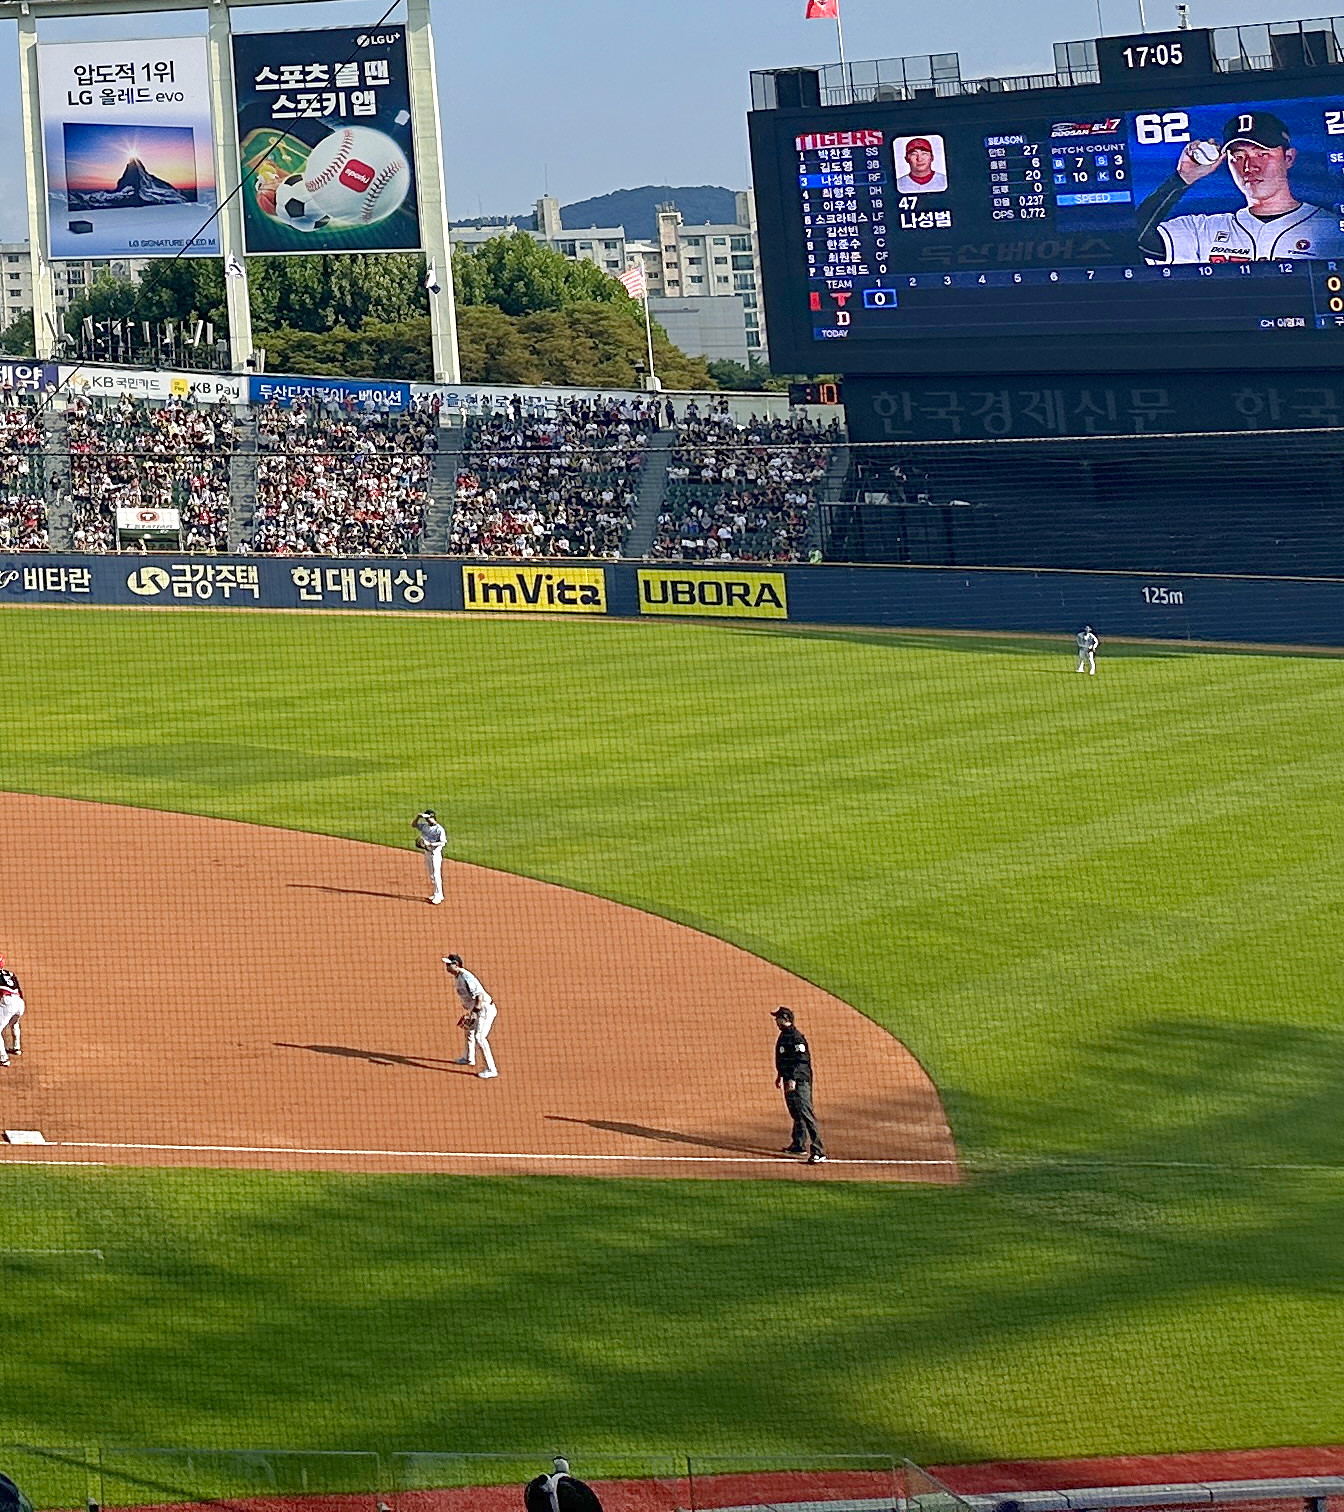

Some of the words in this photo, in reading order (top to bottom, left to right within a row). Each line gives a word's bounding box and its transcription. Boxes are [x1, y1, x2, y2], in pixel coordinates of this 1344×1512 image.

[1123, 44, 1183, 68] 17:05
[73, 63, 135, 86] 압도적
[141, 61, 175, 83] 1위
[255, 64, 330, 91] 스포츠
[334, 62, 359, 87] 볼
[364, 60, 389, 85] 땐
[68, 90, 93, 106] LG
[99, 88, 153, 105] 올레드
[156, 92, 184, 102] evo
[272, 92, 347, 119] 스포키
[351, 90, 376, 116] 앱
[1135, 112, 1190, 144] 62
[1238, 115, 1253, 132] D
[796, 129, 884, 151] TIGERS
[988, 136, 1023, 144] SEASON
[866, 148, 878, 156] SS
[1023, 145, 1038, 155] 27
[1052, 146, 1083, 155] PITCH
[1086, 144, 1125, 152] COUNT
[820, 161, 853, 172] 김도영
[867, 161, 879, 169] 3B
[1032, 158, 1040, 167] 6
[1075, 158, 1083, 167] 7
[1114, 155, 1123, 165] 3
[821, 173, 854, 186] 나성범
[868, 173, 881, 181] RF
[1026, 171, 1041, 180] 20
[1073, 172, 1088, 182] 10
[1116, 170, 1124, 179] 0
[870, 187, 882, 195] DH
[1034, 182, 1042, 192] 0
[899, 197, 917, 209] 47
[1019, 195, 1043, 206] 0.237
[1075, 193, 1111, 203] SPEED
[823, 200, 857, 211] 이우성
[871, 200, 883, 208] 1B
[872, 213, 884, 221] LF
[901, 211, 952, 228] 나성범
[1021, 208, 1045, 219] 0.772
[873, 226, 886, 234] 2B
[141, 239, 184, 247] SIGNATURE
[877, 239, 885, 247] C
[876, 252, 889, 260] CF
[826, 280, 852, 289] TEAM
[909, 277, 917, 286] 2
[944, 276, 952, 286] 3
[978, 274, 986, 284] 4
[1014, 274, 1022, 283] 5
[1050, 272, 1058, 282] 6
[1087, 270, 1095, 280] 7
[1125, 269, 1133, 278] 8
[1162, 267, 1171, 277] 9
[1198, 266, 1213, 276] 10
[1240, 265, 1251, 275] 11
[1279, 263, 1293, 273] 12
[874, 292, 885, 305] 0
[1327, 276, 1341, 292] 0
[836, 311, 851, 326] D
[1329, 297, 1343, 311] 0
[822, 330, 849, 338] TODAY
[93, 376, 113, 388] KB
[116, 377, 161, 391] 국민카드
[193, 382, 210, 395] KB
[216, 383, 240, 399] Pay
[872, 389, 1177, 436] 한국경제신문
[24, 567, 92, 593] 비타란
[170, 564, 260, 599] 금강주택
[291, 565, 427, 603] 현대해상
[642, 578, 785, 609] UBORA
[1142, 586, 1184, 605] 125m
